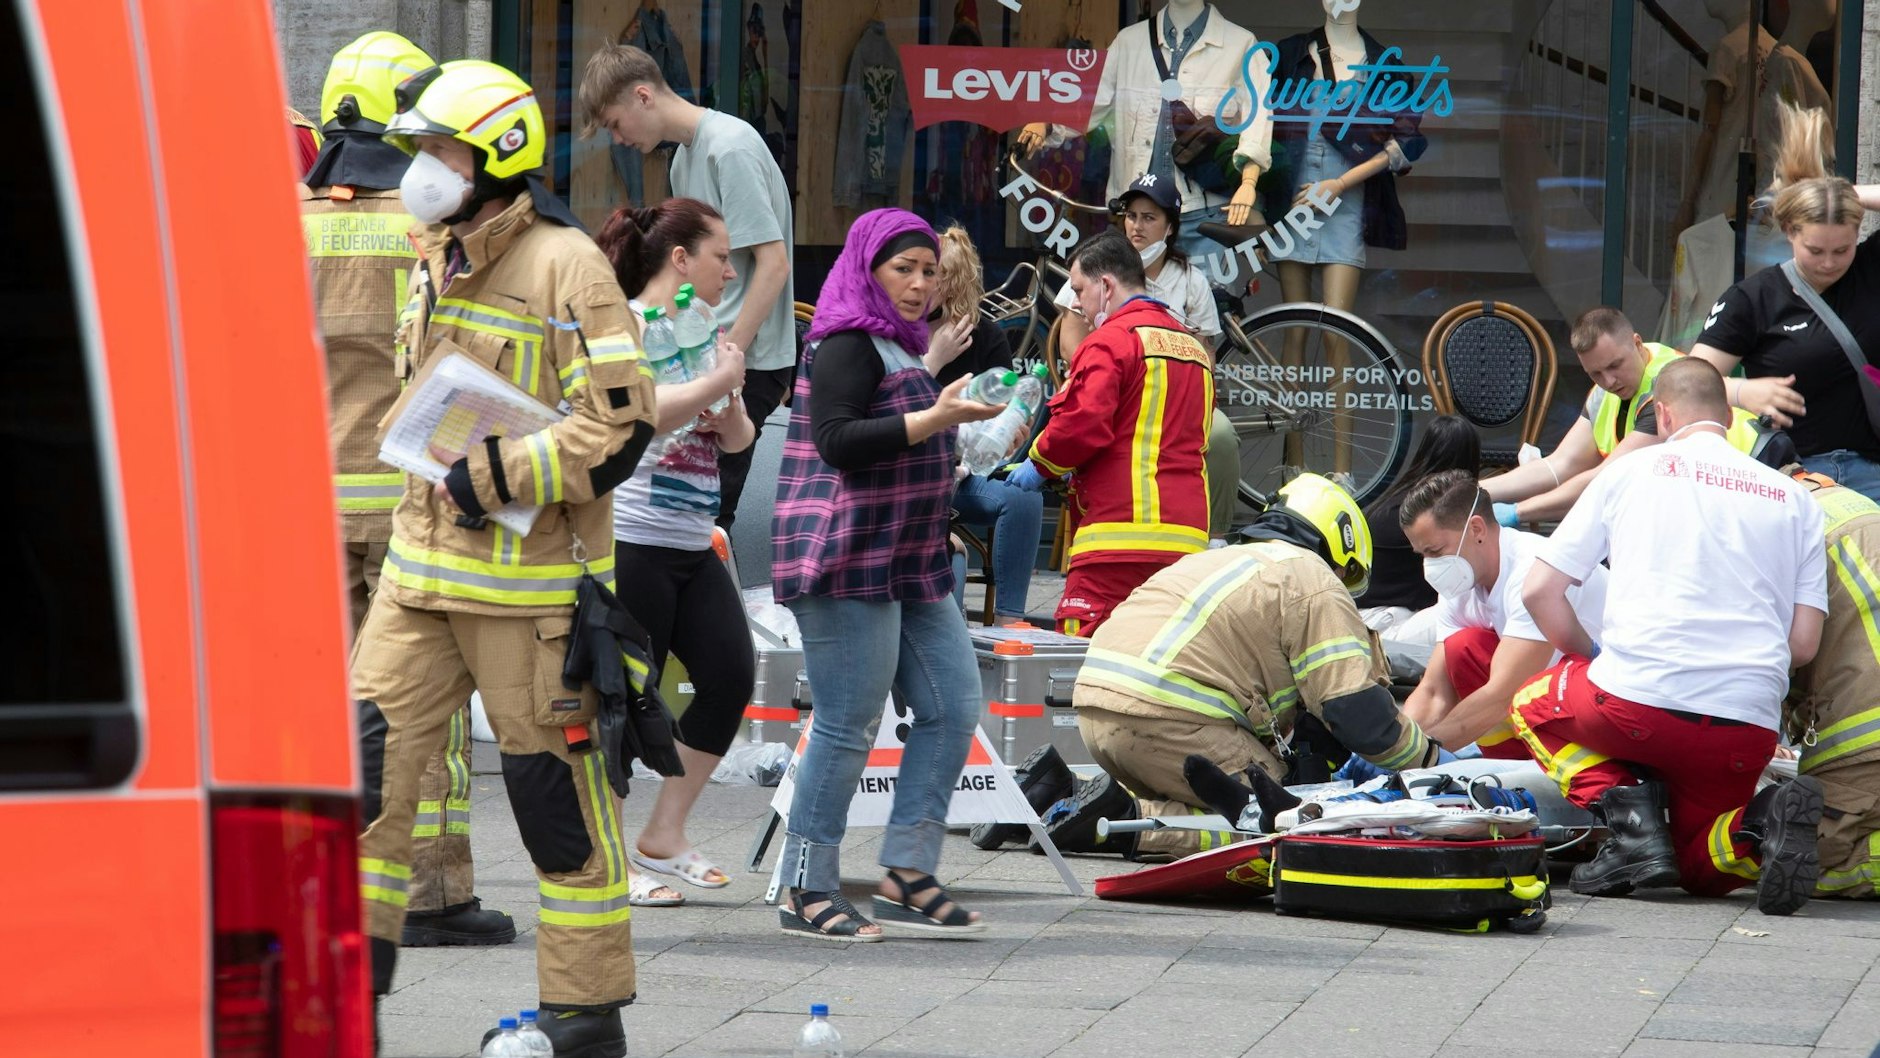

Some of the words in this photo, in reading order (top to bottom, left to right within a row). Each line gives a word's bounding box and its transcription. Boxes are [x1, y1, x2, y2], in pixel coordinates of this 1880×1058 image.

[1215, 41, 1454, 141] Swapfiets
[321, 218, 387, 233] BERLINER
[999, 173, 1080, 260] FOR
[1214, 363, 1336, 384] EMBERSHIP
[1342, 366, 1385, 386] FOR
[1228, 389, 1271, 407] FOR
[1277, 391, 1338, 409] MORE
[1695, 460, 1758, 481] BERLINER
[1695, 470, 1787, 504] FEUERWEHR
